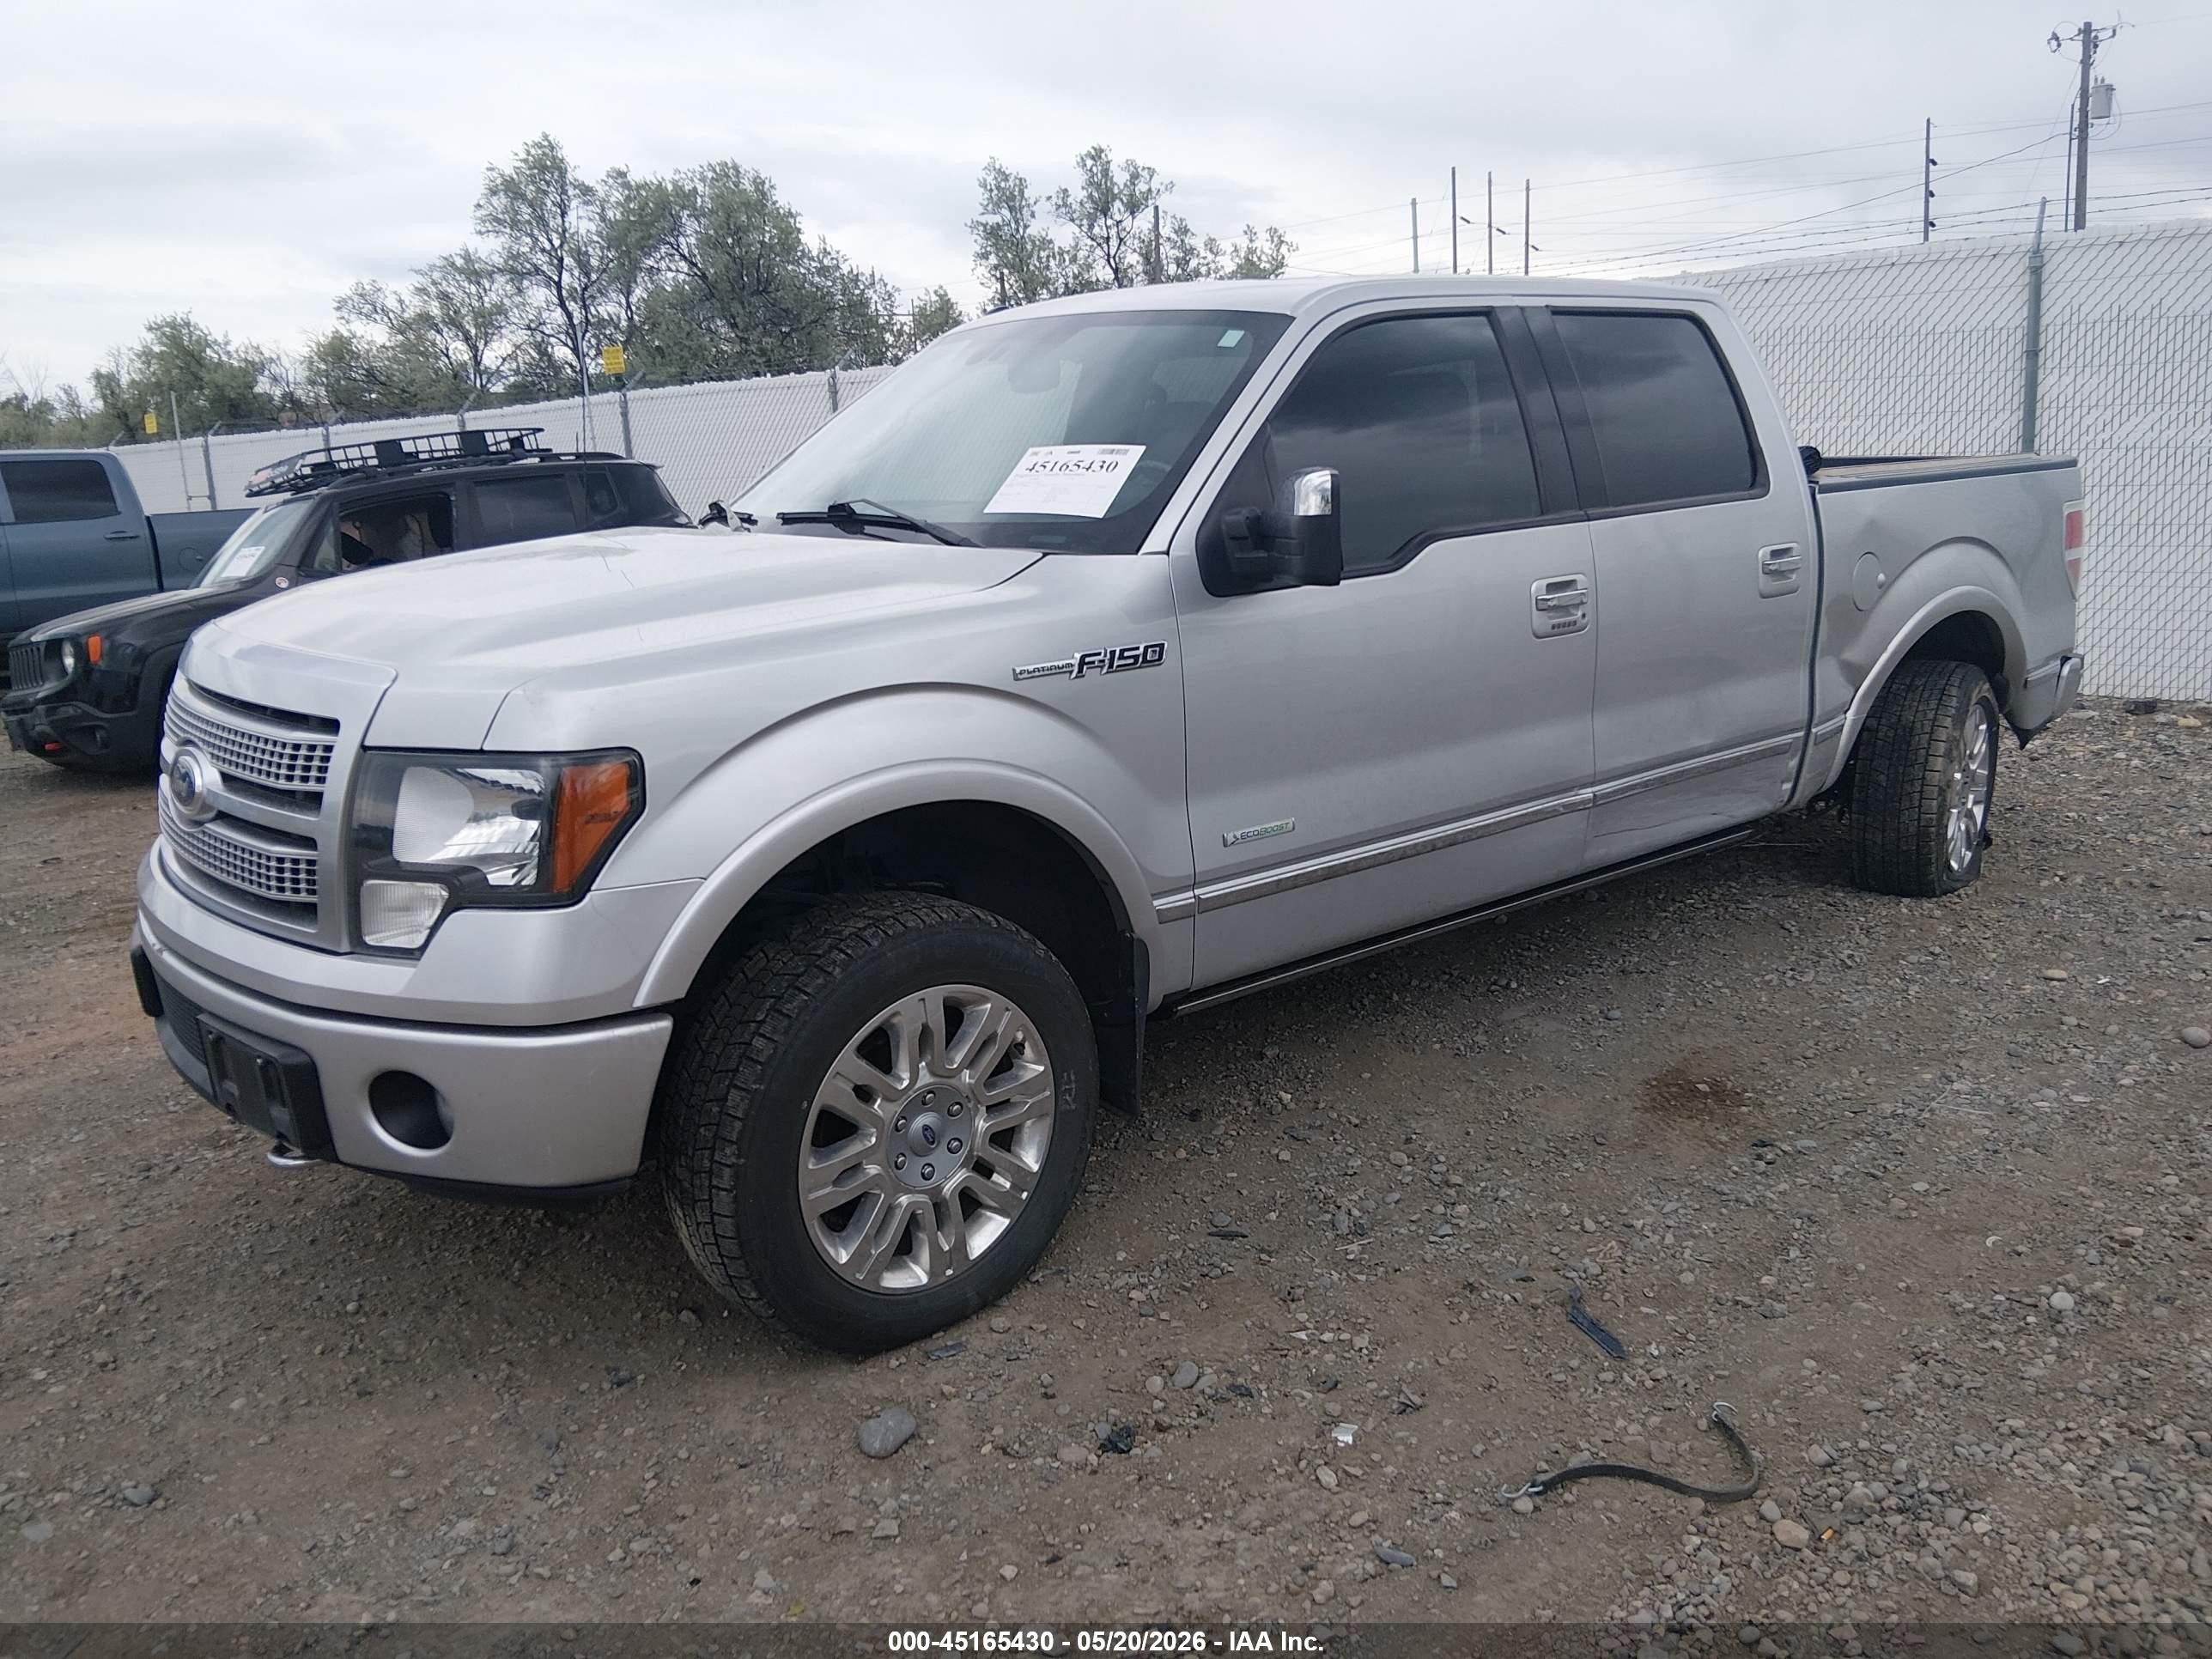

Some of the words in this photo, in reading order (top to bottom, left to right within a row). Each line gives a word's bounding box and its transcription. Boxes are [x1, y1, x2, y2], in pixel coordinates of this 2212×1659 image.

[1024, 459, 1119, 473] 45165430
[1018, 662, 1074, 676] PLATINUM
[1072, 641, 1167, 678] F-150
[1240, 822, 1290, 840] ECOBOOST
